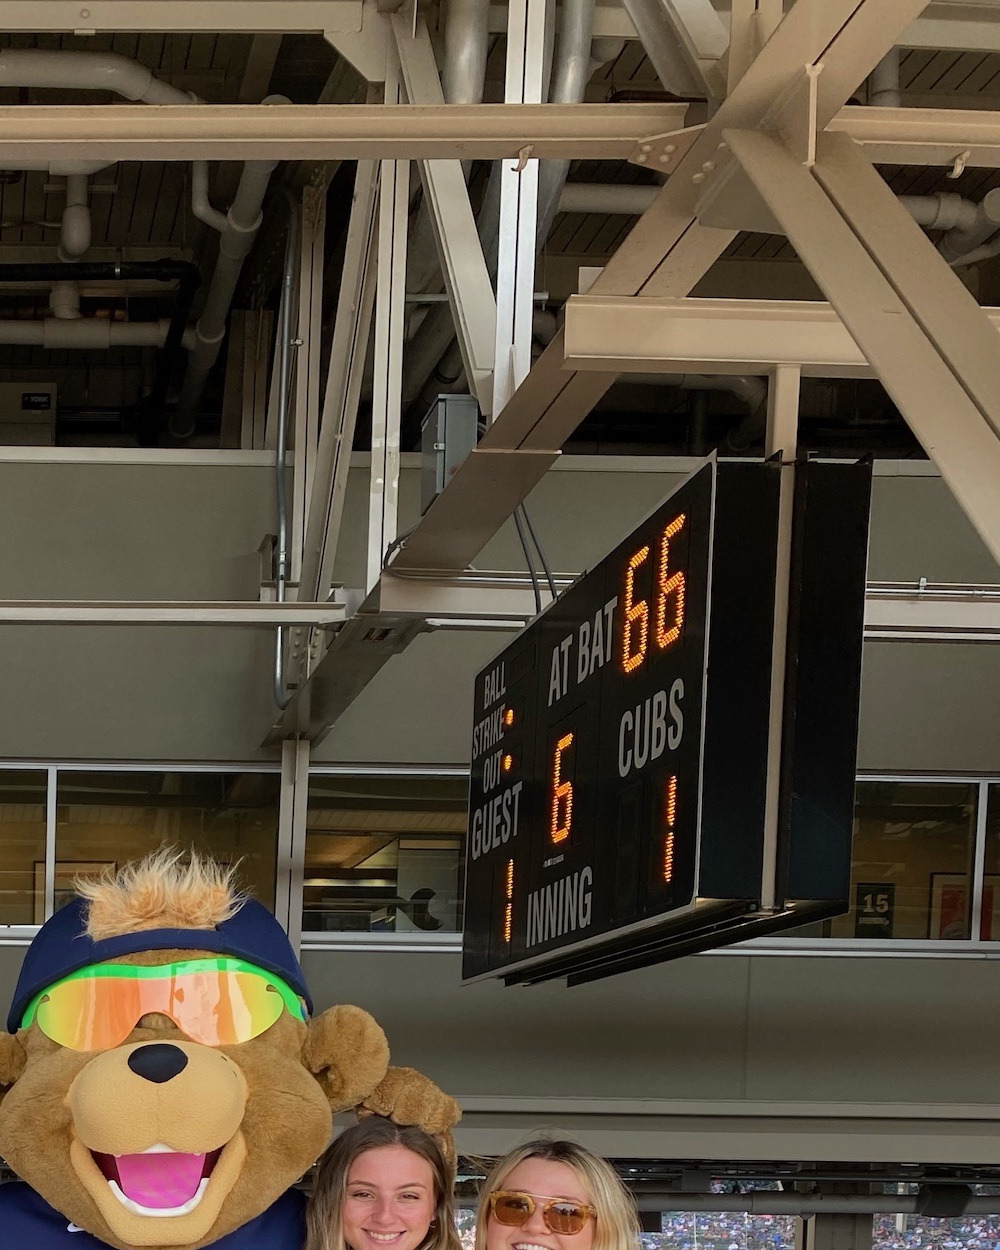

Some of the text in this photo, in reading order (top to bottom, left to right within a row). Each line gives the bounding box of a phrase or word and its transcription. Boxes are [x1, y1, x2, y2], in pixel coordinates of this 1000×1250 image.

[547, 512, 686, 707] AT BAT 66
[483, 661, 507, 711] BALL
[617, 677, 685, 778] CUBS
[472, 703, 506, 761] STRIKE
[482, 748, 503, 794] OUT
[471, 780, 523, 861] GUEST
[550, 732, 574, 844] 6
[663, 774, 678, 883] 1
[503, 858, 514, 943] 1
[525, 864, 594, 949] INNING
[863, 893, 889, 913] 15
